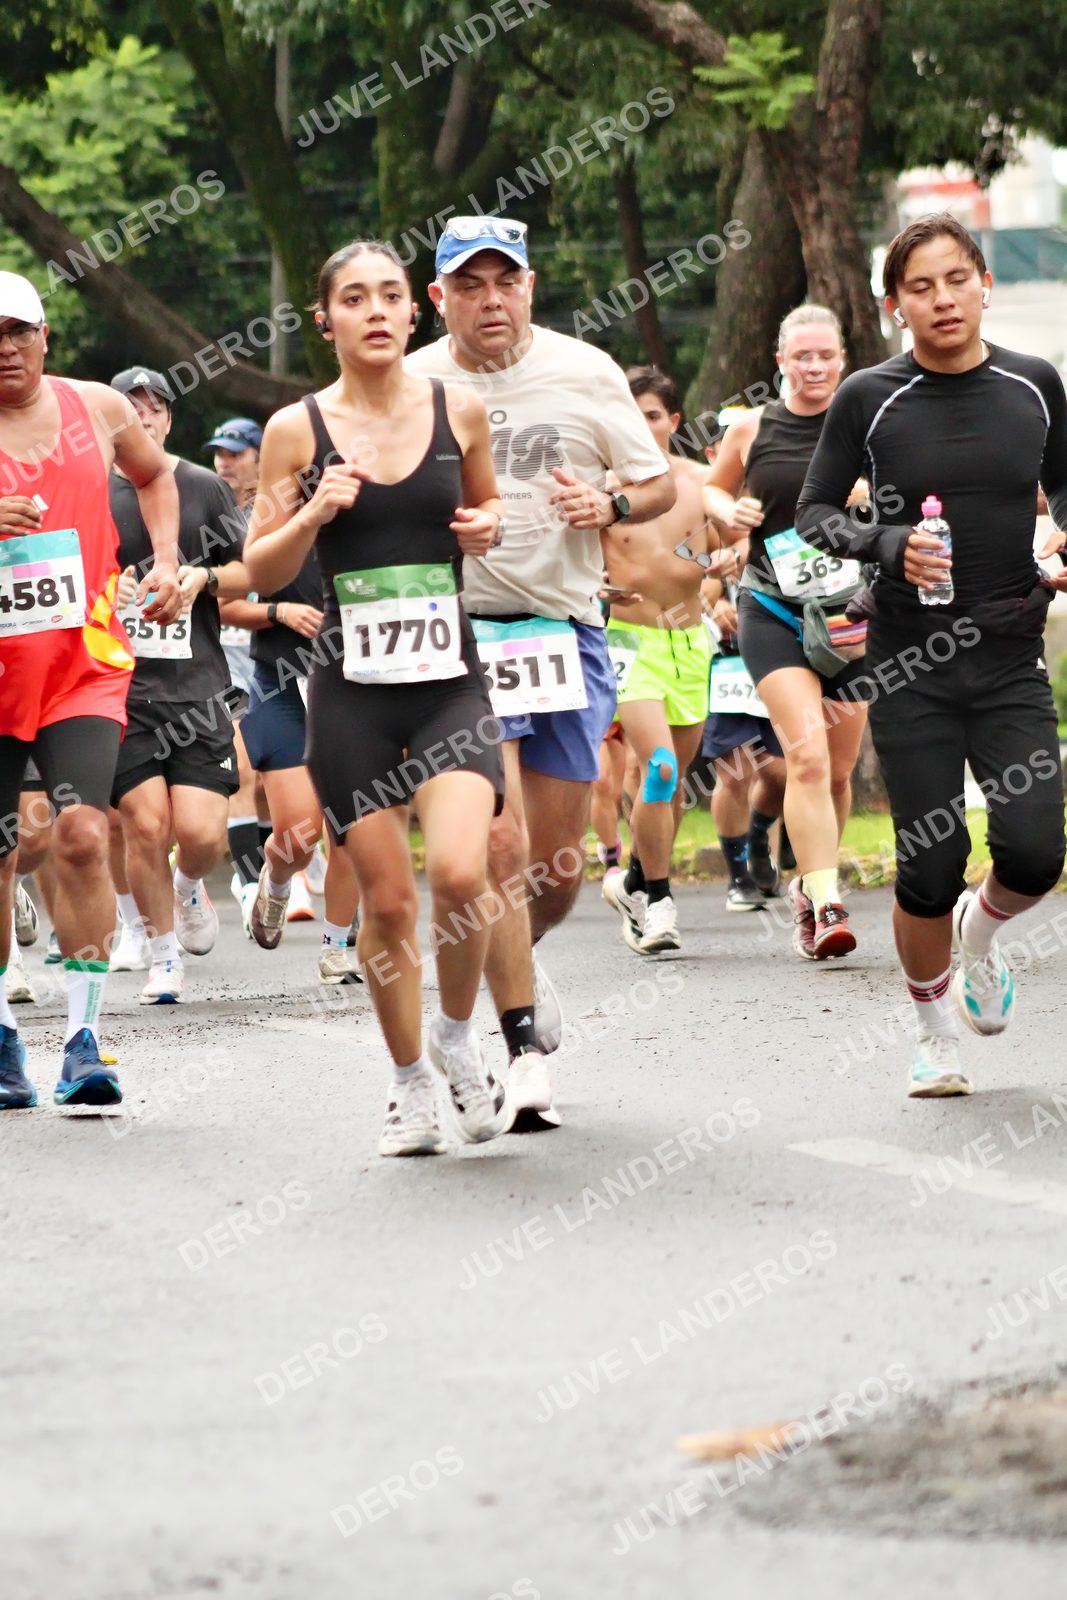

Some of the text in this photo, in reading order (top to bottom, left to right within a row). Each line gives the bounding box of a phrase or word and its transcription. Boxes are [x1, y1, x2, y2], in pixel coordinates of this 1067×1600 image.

[121, 617, 187, 640] 6513
[354, 618, 452, 658] 1770
[717, 682, 762, 702] 547
